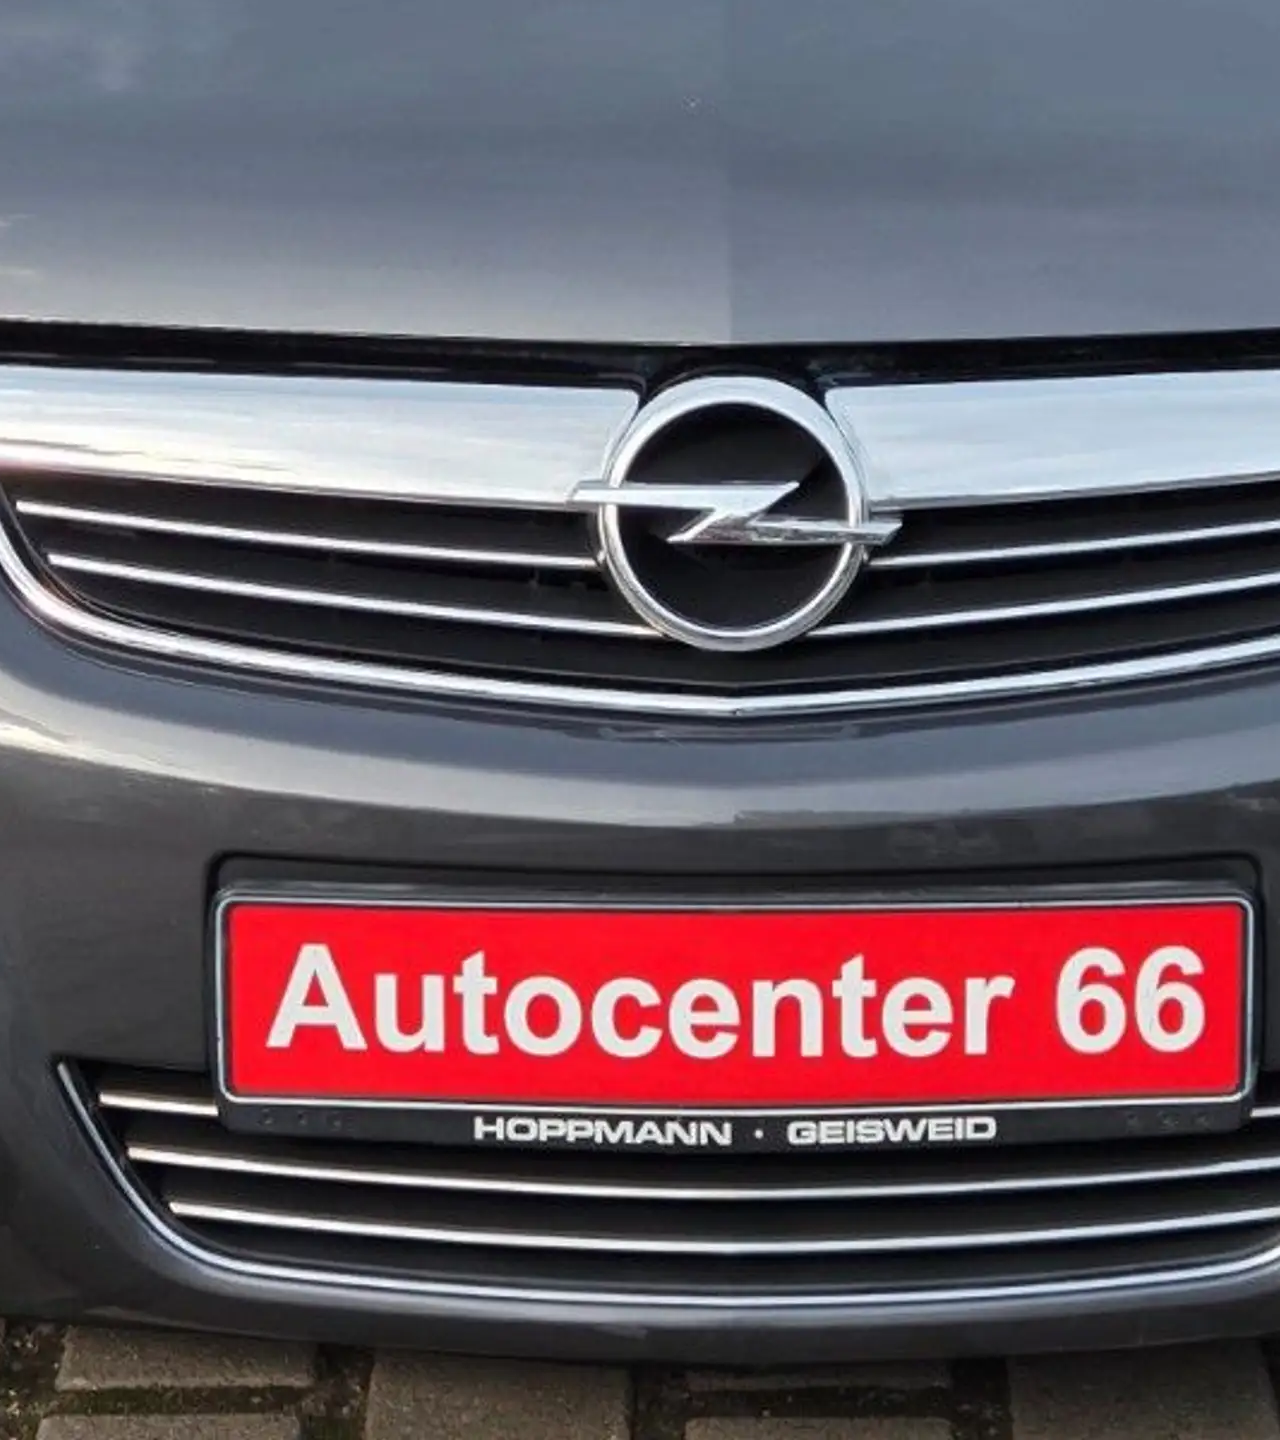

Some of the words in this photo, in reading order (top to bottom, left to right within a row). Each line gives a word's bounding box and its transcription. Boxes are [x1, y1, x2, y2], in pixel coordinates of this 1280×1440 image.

[265, 942, 1016, 1059] Autocenter
[1055, 944, 1206, 1054] 66
[473, 1115, 733, 1146] HOPPMANN
[786, 1116, 998, 1146] GEISWEID
